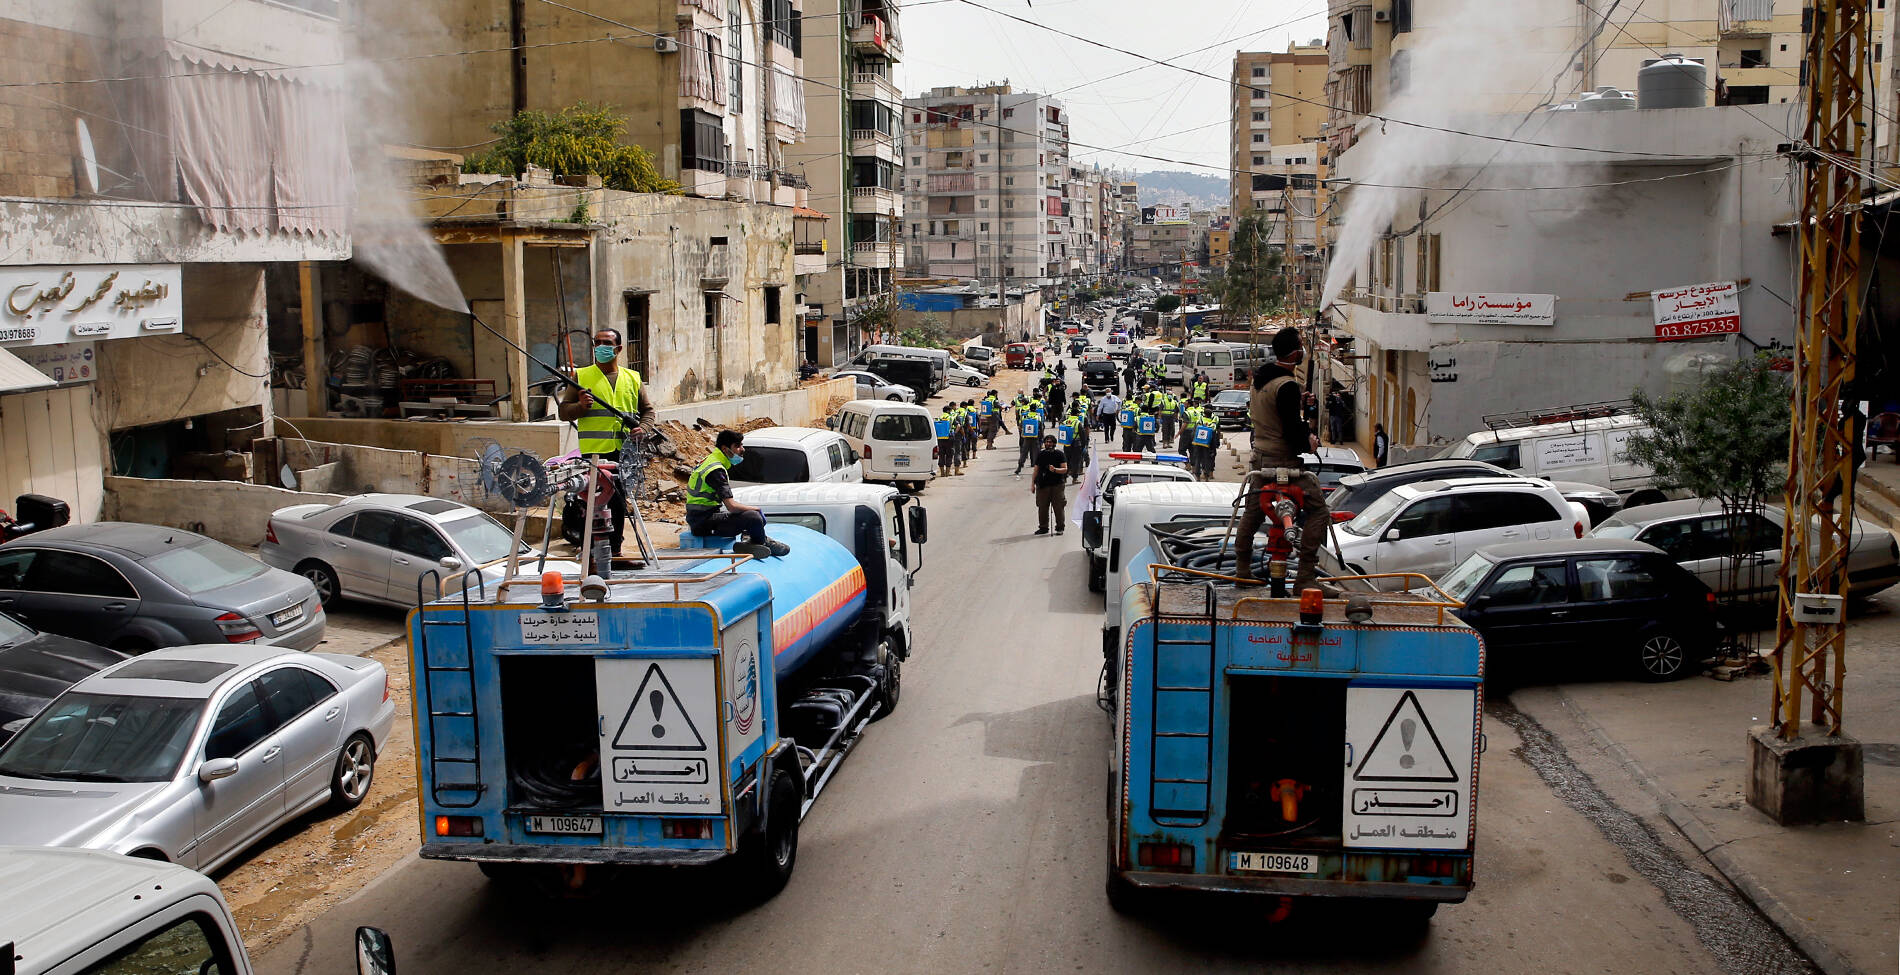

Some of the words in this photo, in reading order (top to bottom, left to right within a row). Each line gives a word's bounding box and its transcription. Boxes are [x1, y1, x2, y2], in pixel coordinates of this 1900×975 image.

[8, 271, 76, 320] شعيب
[65, 271, 120, 313] محمد
[114, 279, 169, 311] الخبير
[1657, 289, 1688, 301] برسم
[1690, 283, 1732, 297] مستودع
[1452, 296, 1475, 311] راما
[1478, 296, 1532, 312] مؤسسة
[0, 328, 36, 341] 03/978685
[1661, 326, 1678, 336] 03
[1683, 320, 1735, 336] 875235
[523, 616, 548, 627] حريك
[550, 616, 569, 626] حارة
[572, 615, 595, 626] بلدية
[524, 632, 550, 642] حريك
[551, 631, 571, 642] حارة
[574, 630, 597, 642] بلدية
[1248, 632, 1282, 645] الضاحية
[620, 760, 701, 780] احذر
[614, 792, 655, 807] العمل
[1360, 792, 1450, 812] احذر
[534, 819, 543, 831] M
[551, 818, 594, 832] 109647
[1350, 824, 1396, 840] العمل
[1240, 854, 1251, 868] M
[1260, 854, 1309, 871] 109648
